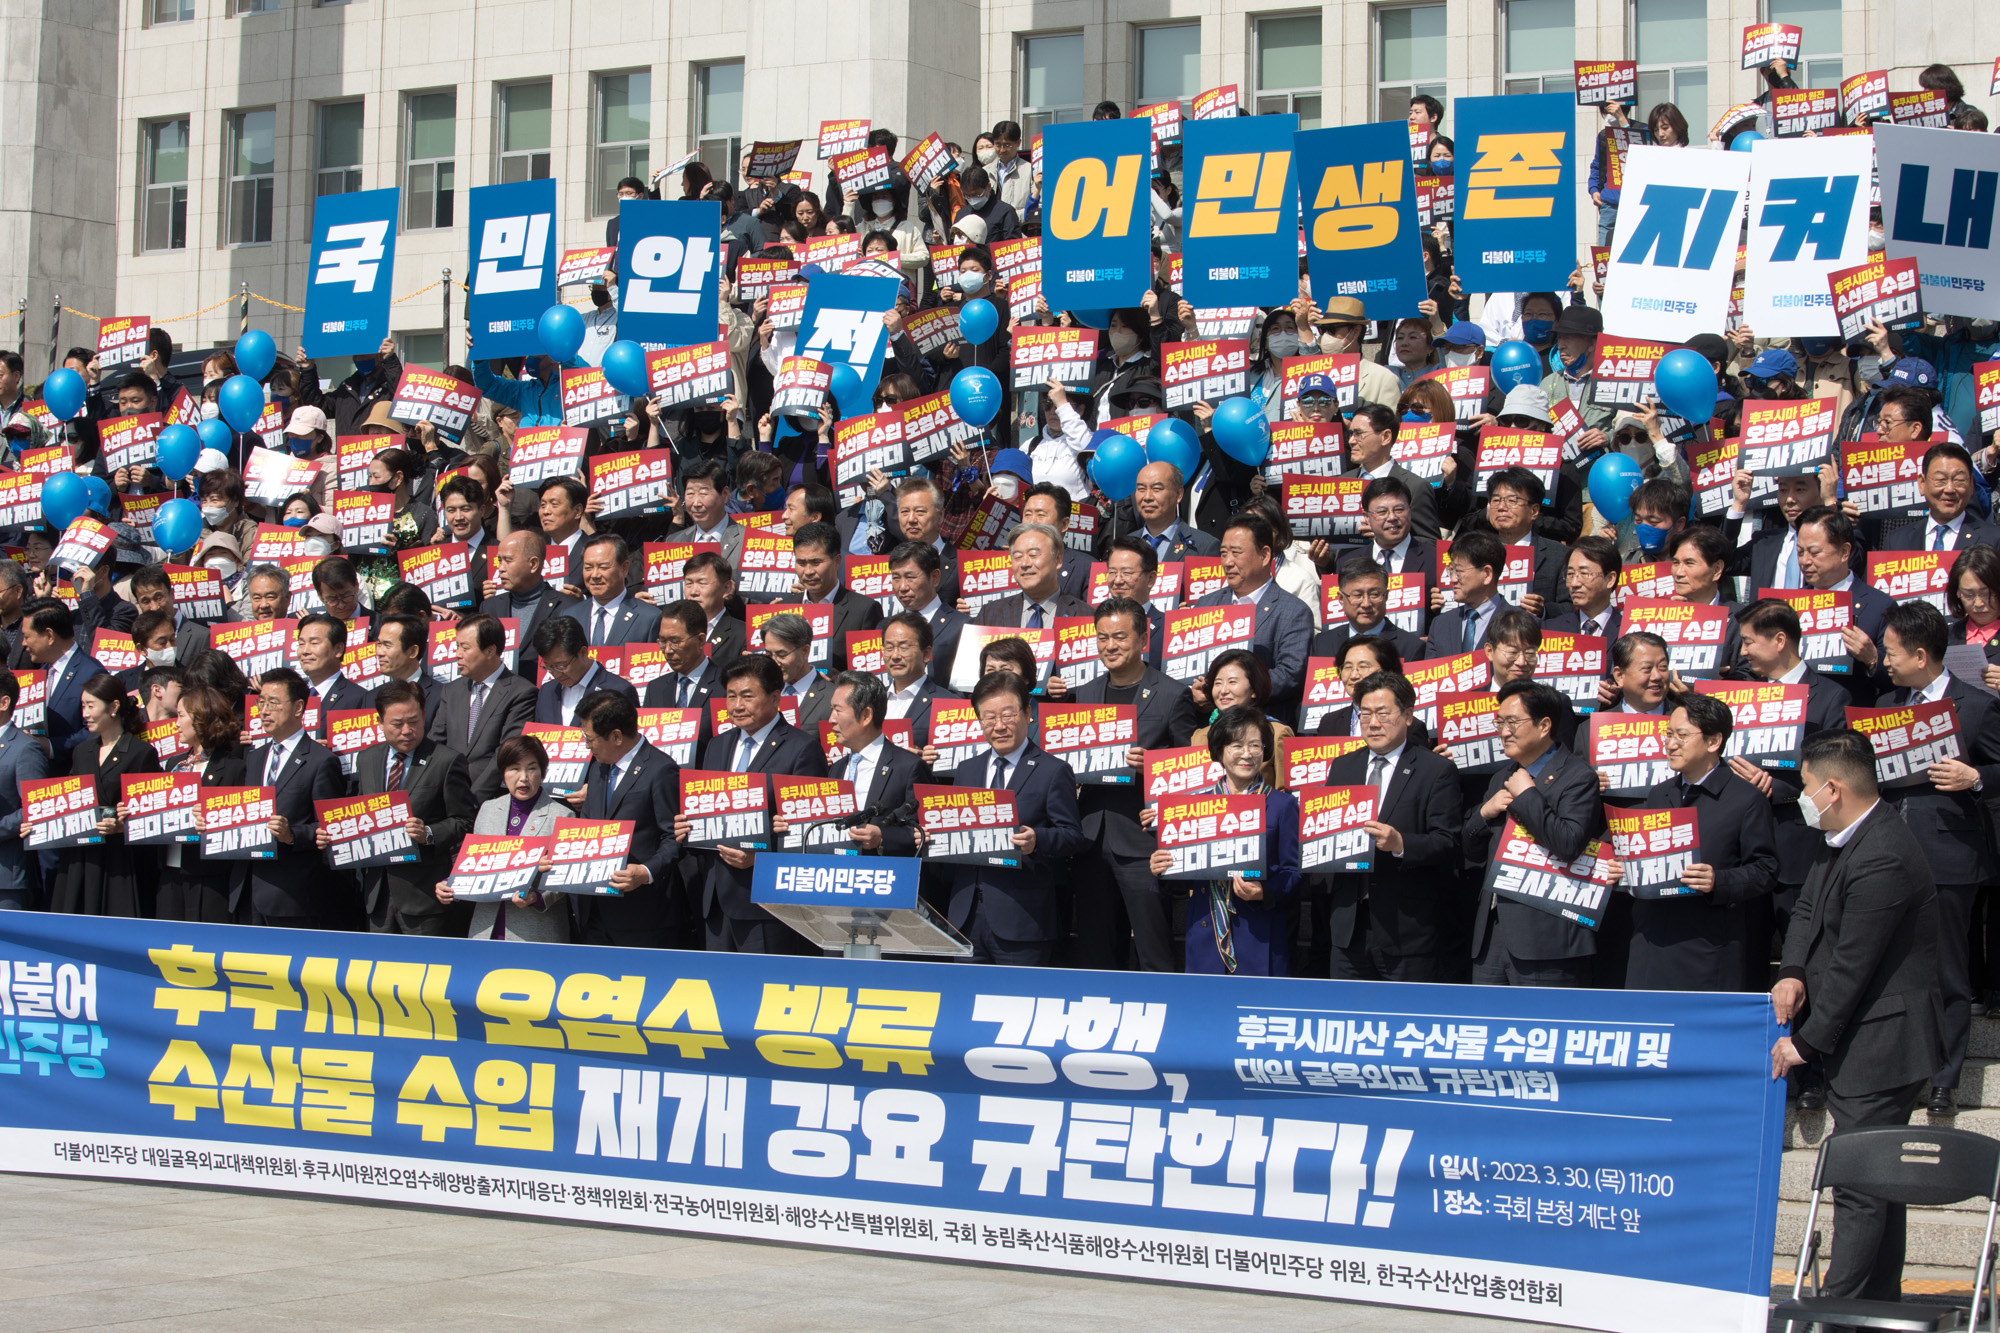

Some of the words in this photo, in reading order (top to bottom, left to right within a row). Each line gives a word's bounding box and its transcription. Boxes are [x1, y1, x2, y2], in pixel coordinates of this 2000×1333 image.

[1579, 62, 1615, 75] 후쿠시마산
[1579, 73, 1611, 87] 수산물
[1611, 68, 1633, 82] 수입
[1580, 88, 1604, 103] 절대
[1606, 82, 1633, 100] 반대
[1463, 131, 1566, 220] 존
[1049, 154, 1142, 240] 어
[1189, 151, 1292, 237] 민
[1312, 160, 1404, 250] 생
[1892, 163, 1998, 250] 내
[1617, 184, 1739, 271] 지
[1759, 175, 1859, 262] 켜
[315, 220, 390, 293] 국
[474, 213, 551, 295] 민
[1482, 249, 1547, 265] 더불어민주당
[623, 236, 714, 314] 안
[1066, 267, 1124, 283] 더불어민주당
[1208, 264, 1271, 281] 더불어민주당
[1337, 278, 1398, 295] 더불어민주당
[1835, 266, 1885, 295] 후쿠시마산
[1919, 274, 1985, 292] 더불어민주당
[1631, 297, 1698, 315] 더불어민주당
[1838, 283, 1884, 314] 수산물
[1882, 270, 1915, 294] 수입
[102, 319, 131, 335] 후쿠시마산
[322, 319, 369, 334] 더불어민주당
[489, 318, 535, 334] 더불어민주당
[1842, 307, 1879, 339] 절대
[1877, 292, 1917, 324] 반대
[100, 329, 128, 348] 수산물
[128, 325, 147, 341] 수입
[1018, 333, 1057, 348] 후쿠시마
[1059, 331, 1080, 343] 원전
[101, 346, 123, 367] 절대
[122, 341, 148, 362] 반대
[1016, 345, 1060, 364] 오염수
[1061, 341, 1094, 358] 방류
[406, 373, 454, 391] 후쿠시마산
[1016, 364, 1055, 386] 결사
[1054, 361, 1090, 383] 저지
[1310, 376, 1321, 386] 12
[400, 384, 443, 408] 수산물
[445, 393, 475, 411] 수입
[392, 401, 428, 425] 절대
[423, 407, 467, 430] 반대
[1745, 420, 1794, 444] 오염수
[1794, 410, 1833, 436] 방류
[1748, 407, 1792, 425] 후쿠시마
[1793, 400, 1818, 417] 원전
[1743, 443, 1787, 471] 결사
[1785, 435, 1828, 464] 저지
[1168, 625, 1215, 654] 수산물
[1216, 617, 1250, 641] 수입
[1170, 609, 1224, 635] 후쿠시마산
[27, 783, 62, 803] 후쿠시마
[64, 778, 81, 793] 원전
[127, 775, 174, 797] 후쿠시마산
[206, 792, 241, 810] 후쿠시마
[243, 788, 260, 803] 원전
[685, 778, 725, 795] 후쿠시마
[728, 774, 748, 790] 원전
[28, 796, 66, 821] 오염수
[66, 787, 94, 809] 방류
[124, 791, 166, 815] 수산물
[169, 784, 197, 805] 수입
[323, 802, 366, 823] 후쿠시마
[368, 795, 391, 811] 원전
[686, 792, 730, 816] 오염수
[732, 787, 764, 809] 방류
[923, 793, 968, 809] 후쿠시마
[972, 791, 995, 805] 원전
[1163, 798, 1228, 822] 후쿠시마산
[1304, 789, 1350, 815] 후쿠시마산
[27, 818, 63, 846] 결사
[64, 809, 98, 836] 저지
[129, 814, 160, 841] 절대
[160, 806, 198, 834] 반대
[204, 806, 244, 829] 오염수
[247, 800, 274, 821] 방류
[327, 815, 374, 840] 오염수
[375, 805, 411, 827] 방류
[686, 816, 726, 842] 결사
[726, 812, 763, 838] 저지
[923, 808, 974, 830] 오염수
[974, 804, 1013, 824] 방류
[1161, 816, 1218, 844] 수산물
[1220, 809, 1260, 834] 수입
[1303, 808, 1344, 837] 수산물
[1344, 800, 1375, 825] 수입
[206, 828, 240, 855] 결사
[240, 821, 273, 848] 저지
[332, 837, 374, 865] 결사
[371, 828, 413, 855] 저지
[557, 825, 596, 842] 후쿠시마
[596, 822, 619, 837] 원전
[926, 831, 970, 857] 결사
[968, 828, 1014, 853] 저지
[550, 839, 597, 860] 오염수
[596, 834, 630, 855] 방류
[1211, 835, 1259, 867] 반대
[1303, 837, 1334, 868] 절대
[1335, 828, 1373, 859] 반대
[545, 861, 588, 886] 결사
[584, 857, 625, 882] 저지
[776, 866, 896, 895] 더불어민주당
[148, 944, 457, 1041] 후쿠시마
[475, 968, 730, 1059] 오염수
[754, 982, 941, 1075] 방류
[964, 994, 1189, 1104] 강행,
[1236, 1015, 1390, 1057] 후쿠시마산
[1393, 1021, 1488, 1061] 수산물
[1493, 1026, 1558, 1064] 수입
[1564, 1030, 1631, 1067] 반대
[1637, 1032, 1671, 1068] 및
[1234, 1057, 1300, 1086] 대일
[1301, 1062, 1428, 1093] 굴욕외교
[1429, 1068, 1559, 1102] 규탄대회
[148, 1039, 375, 1136] 수산물
[396, 1054, 555, 1152] 수입
[575, 1066, 747, 1169] 재개
[767, 1079, 946, 1188] 강요
[971, 1095, 1414, 1228] 규탄한다!
[1595, 1168, 1626, 1195] (목)
[1628, 1173, 1674, 1197] 11:00
[54, 1141, 139, 1166] 더불어민주당
[943, 1222, 978, 1246] 국회
[982, 1224, 1209, 1268] 농림축산식품해양수산위원회
[1215, 1248, 1324, 1280] 더불어민주당
[1330, 1258, 1372, 1287] 위원,
[1377, 1263, 1563, 1308] 한국수산산업총연합회
[1493, 1195, 1531, 1223] 국회
[1535, 1199, 1573, 1227] 본청
[1578, 1204, 1617, 1231] 계단
[1620, 1208, 1641, 1234] 앞
